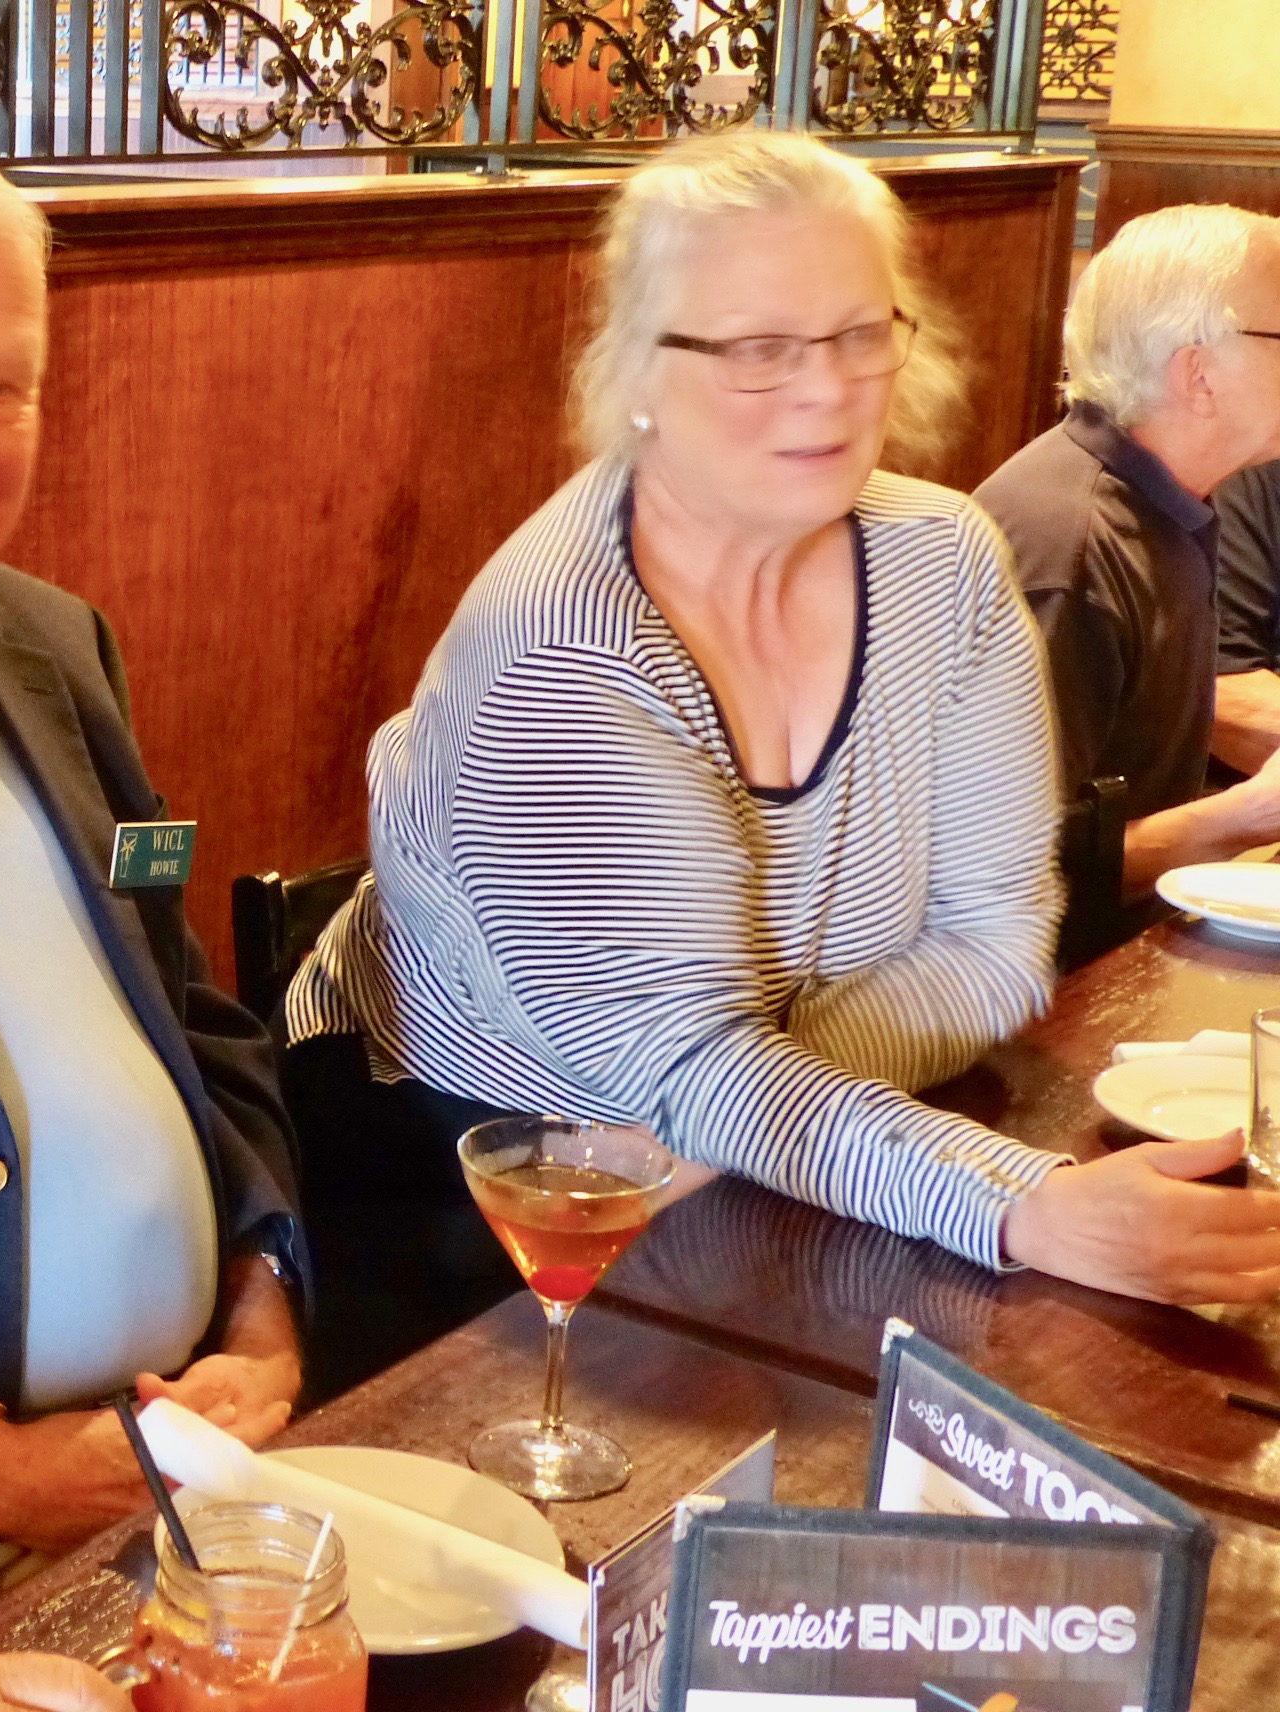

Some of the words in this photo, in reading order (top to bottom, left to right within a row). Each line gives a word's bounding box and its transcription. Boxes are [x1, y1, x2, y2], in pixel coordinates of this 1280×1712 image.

[150, 860, 179, 876] HOWIE
[940, 1413, 1016, 1490] Sweet
[1021, 1452, 1142, 1524] TOO
[612, 1589, 668, 1669] TAK
[709, 1600, 855, 1664] Tappiest
[858, 1604, 1137, 1654] ENDINGS
